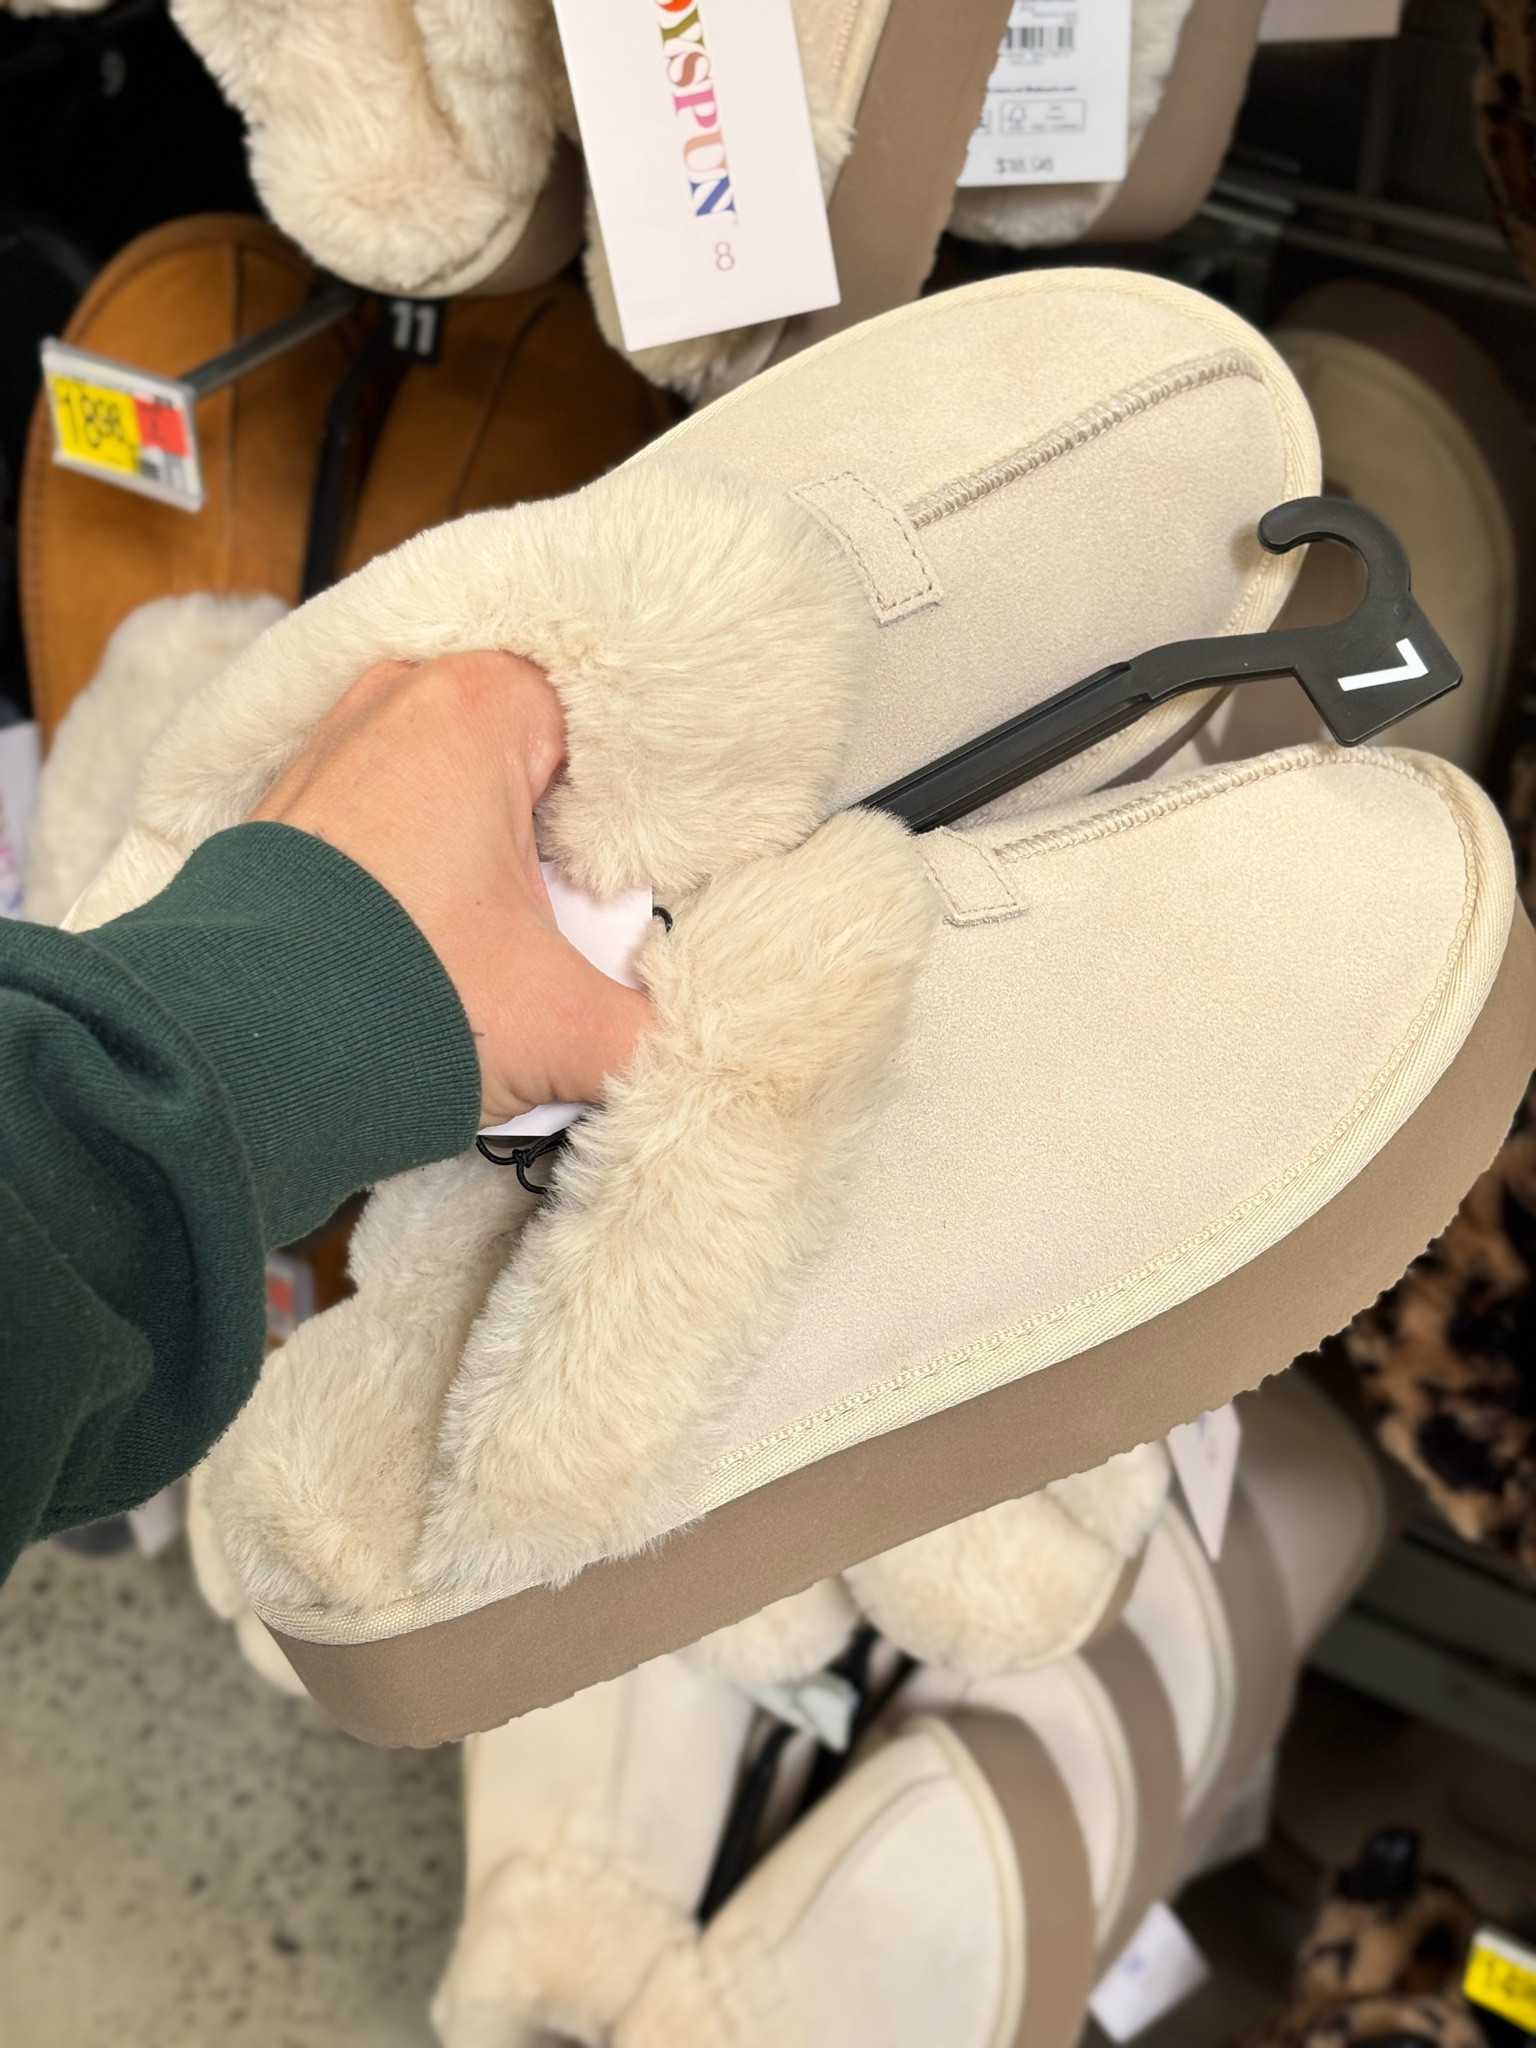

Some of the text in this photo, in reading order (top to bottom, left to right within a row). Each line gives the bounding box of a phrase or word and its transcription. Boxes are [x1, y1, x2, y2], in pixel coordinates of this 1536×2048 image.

[655, 0, 736, 217] YSPUN
[715, 241, 735, 272] 8
[390, 300, 438, 355] 11
[1337, 637, 1429, 692] 7
